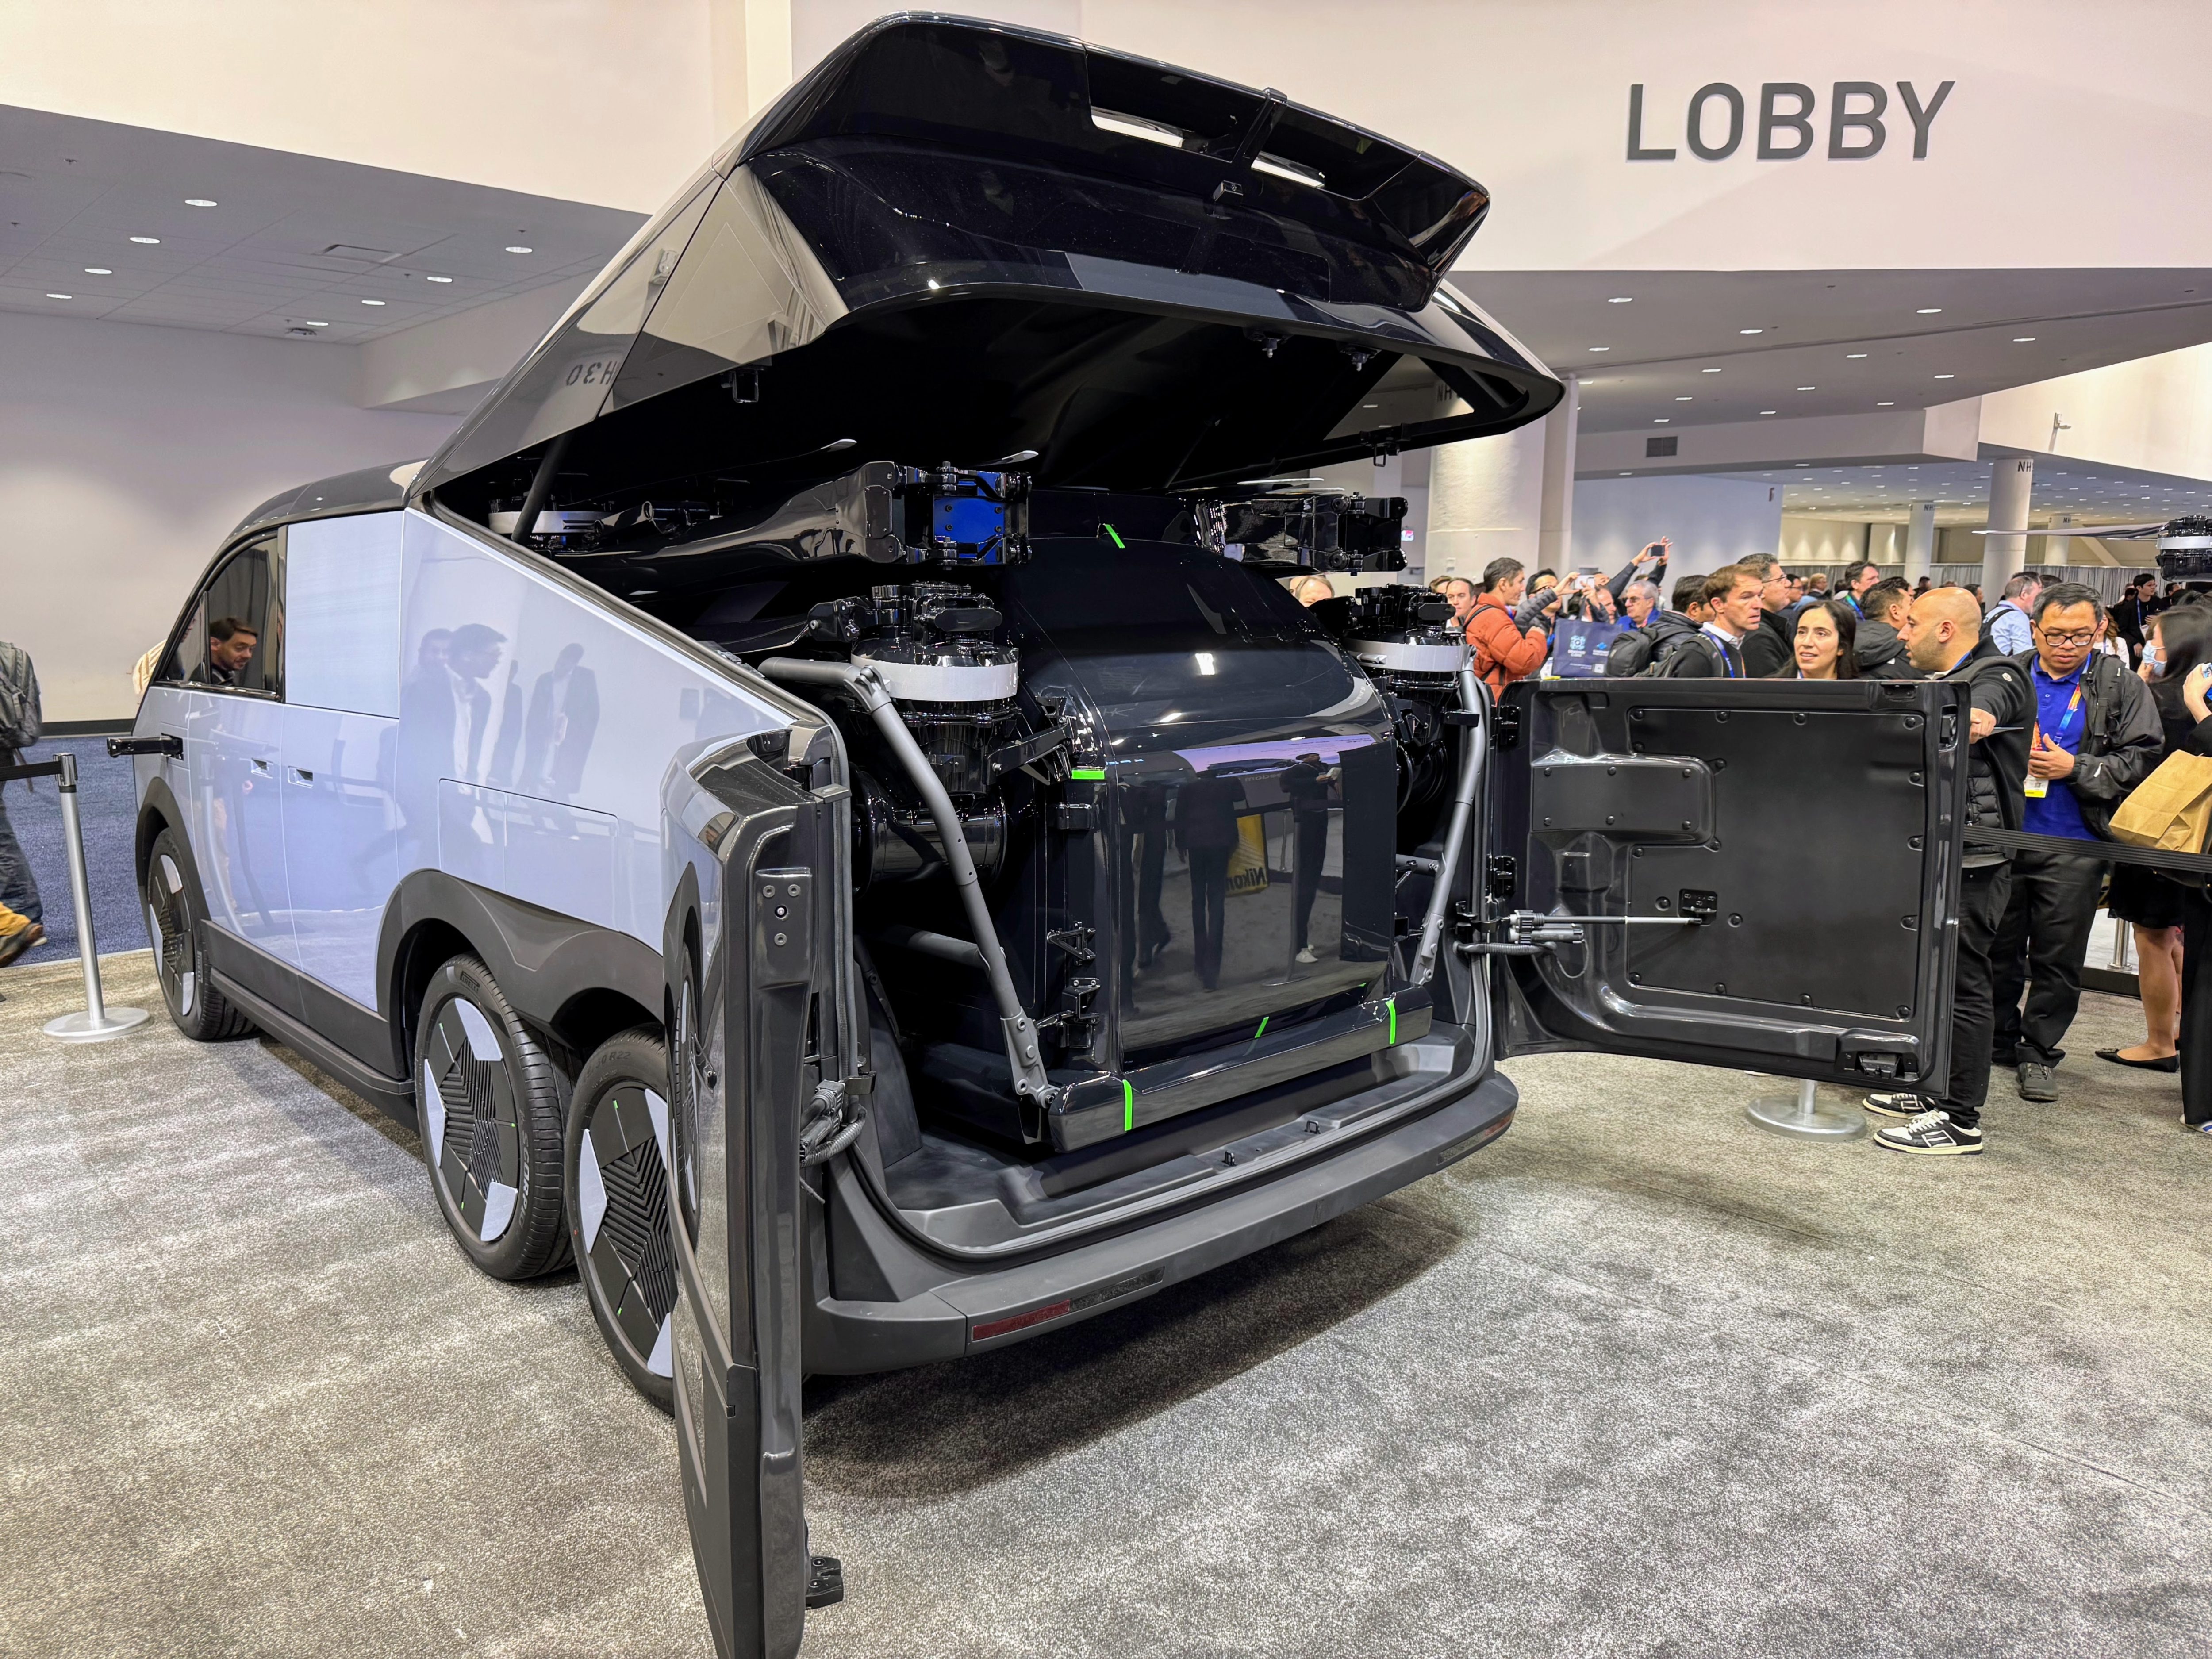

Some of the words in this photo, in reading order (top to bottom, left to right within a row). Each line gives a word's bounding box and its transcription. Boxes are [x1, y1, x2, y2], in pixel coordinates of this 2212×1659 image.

[1626, 81, 1956, 161] LOBBY
[2018, 461, 2033, 472] NH
[518, 1130, 530, 1229] SCORPIO
